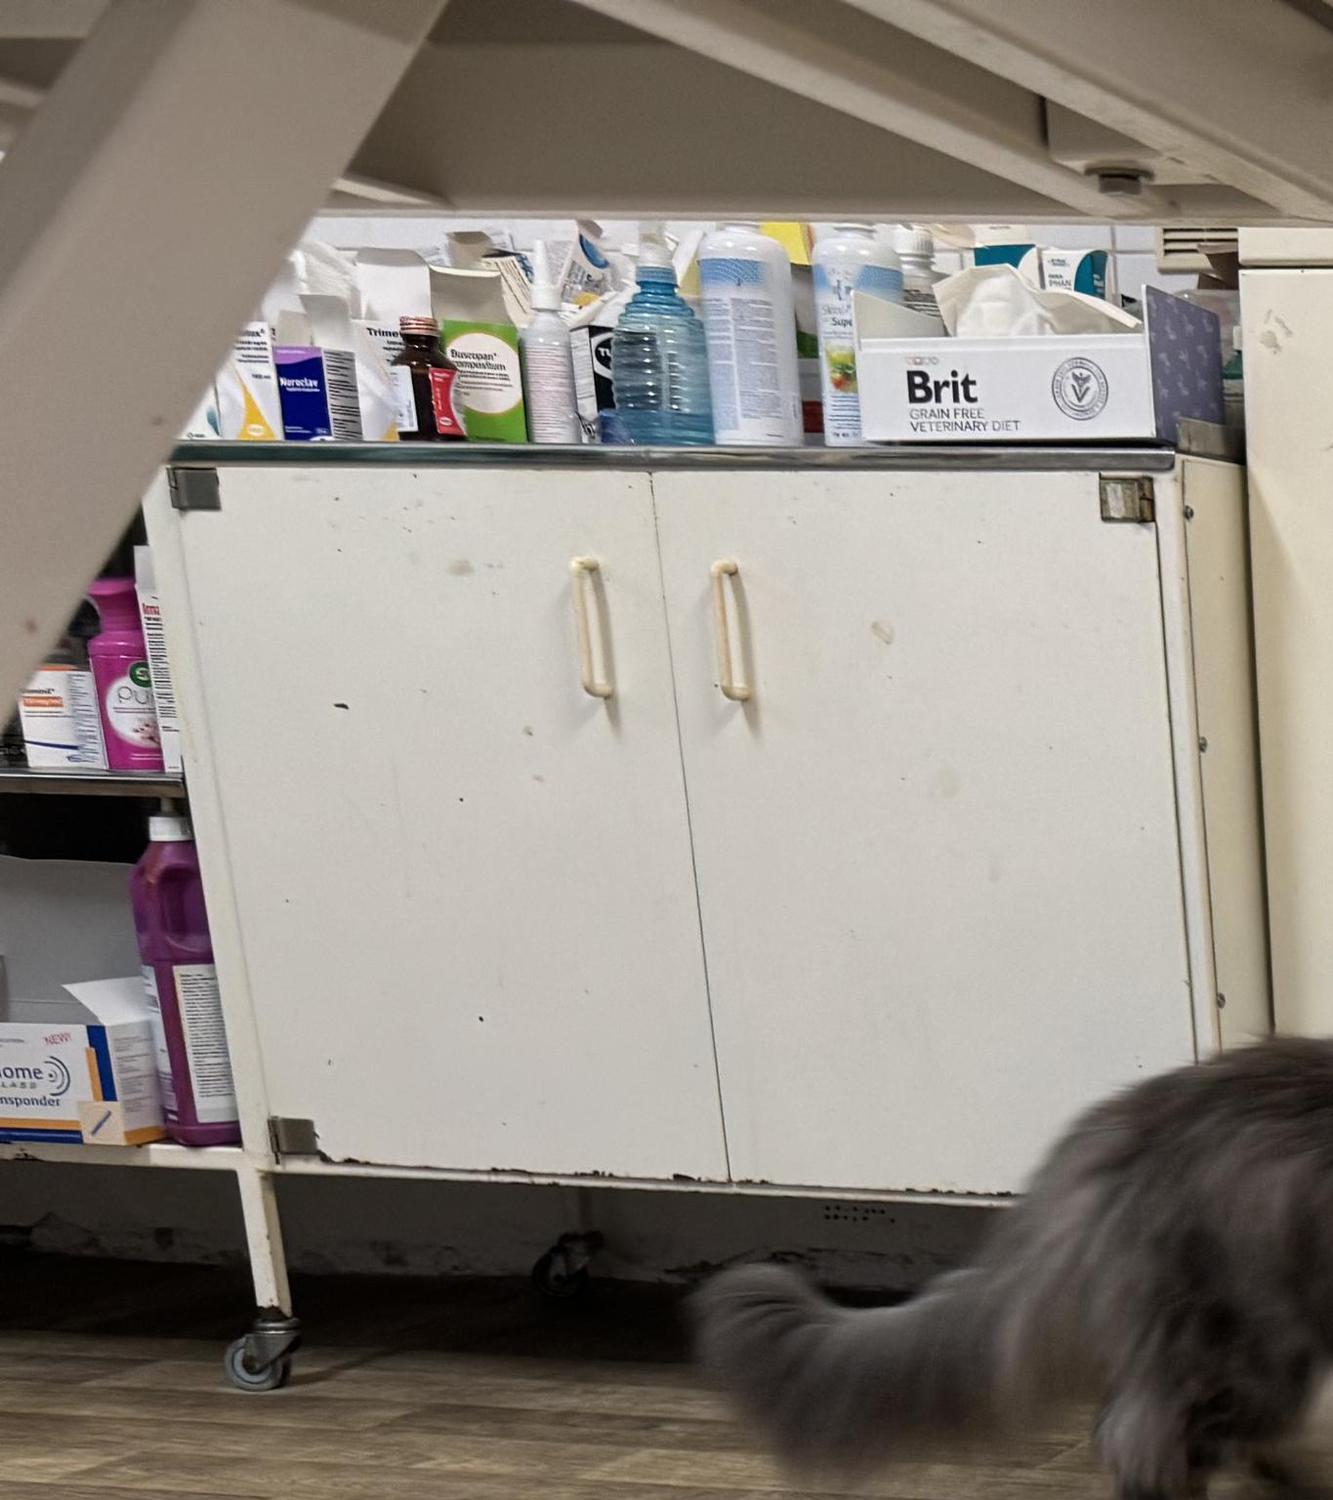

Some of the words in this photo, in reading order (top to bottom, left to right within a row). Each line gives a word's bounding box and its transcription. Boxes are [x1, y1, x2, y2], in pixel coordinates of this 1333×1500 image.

[366, 327, 401, 339] Trime
[906, 369, 978, 404] Brit
[909, 408, 951, 420] GRAIN
[953, 408, 985, 419] FREE
[910, 420, 988, 433] VETERINARY
[992, 420, 1021, 431] DIET
[0, 1066, 44, 1080] ome
[0, 1095, 61, 1107] nsponder
